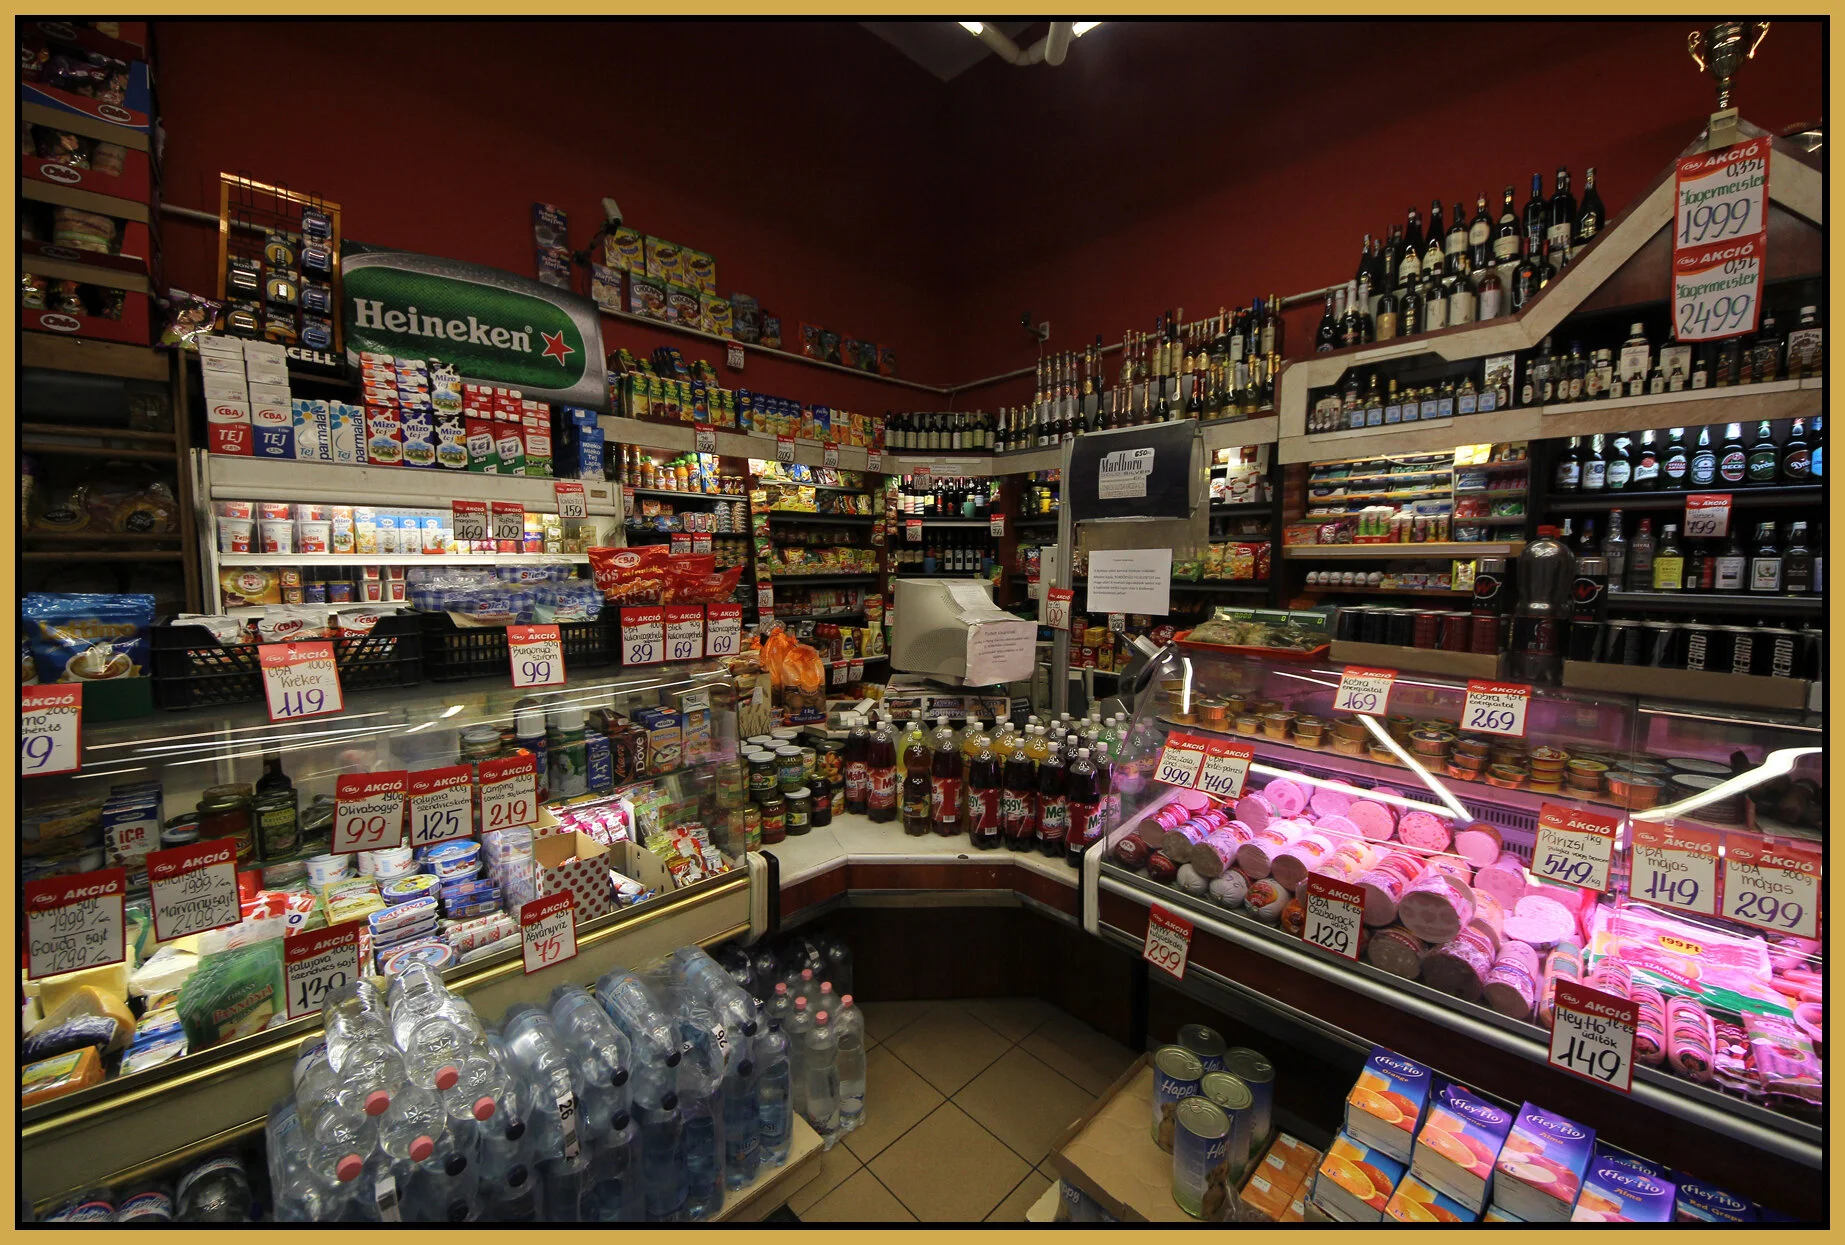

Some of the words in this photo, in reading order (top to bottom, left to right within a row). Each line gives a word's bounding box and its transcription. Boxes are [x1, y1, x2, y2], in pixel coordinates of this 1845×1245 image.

[1704, 142, 1759, 167] AKCIÓ
[1700, 242, 1754, 264] AKCIÓ
[353, 298, 532, 352] Heineken
[218, 406, 240, 417] CBA
[261, 411, 284, 422] CBA
[372, 420, 396, 430] Mizo
[406, 424, 430, 434] Mizo
[440, 428, 462, 436] Mizo
[219, 430, 244, 443] TEJ
[263, 433, 286, 445] TEJ
[320, 409, 330, 461] parmalat
[356, 410, 366, 464] parmalat
[495, 525, 519, 539] 109
[278, 620, 300, 632] CBA
[528, 632, 557, 641] AKCIÓ
[675, 641, 693, 658] 69
[714, 636, 732, 653] 69
[291, 650, 329, 660] AKCIÓ
[522, 661, 552, 683] 99
[1362, 671, 1392, 679] AKCIÓ
[1491, 687, 1527, 695] AKCIÓ
[22, 694, 75, 707] AKCIÓ
[1471, 708, 1515, 731] 269
[1182, 742, 1206, 751] AKCIÓ
[1224, 749, 1250, 758] AKCIÓ
[501, 764, 533, 777] AKCIÓ
[364, 780, 403, 793] AKCIÓ
[433, 774, 469, 787] AKCIÓ
[490, 800, 528, 827] 219
[417, 809, 463, 840] 125
[1567, 820, 1611, 834] AKCIÓ
[1664, 837, 1712, 852] AKCIÓ
[182, 850, 230, 869] AKCIÓ
[1760, 854, 1815, 872] AKCIÓ
[1543, 854, 1593, 884] 549
[64, 881, 118, 900] AKCIÓ
[1328, 889, 1361, 904] AKCIÓ
[540, 900, 570, 916] AKCIÓ
[1165, 921, 1189, 936] AKCIÓ
[31, 938, 77, 957] Gouda
[314, 933, 355, 951] AKCIÓ
[1661, 936, 1684, 947] 199
[1148, 940, 1181, 971] 299
[1644, 962, 1690, 985] SZALONNA
[1584, 1001, 1632, 1021] AKCIÓ
[1382, 1068, 1409, 1083] Orange
[1540, 1132, 1565, 1145] Alma
[1614, 1187, 1644, 1202] Alma
[1688, 1199, 1709, 1211] Red
